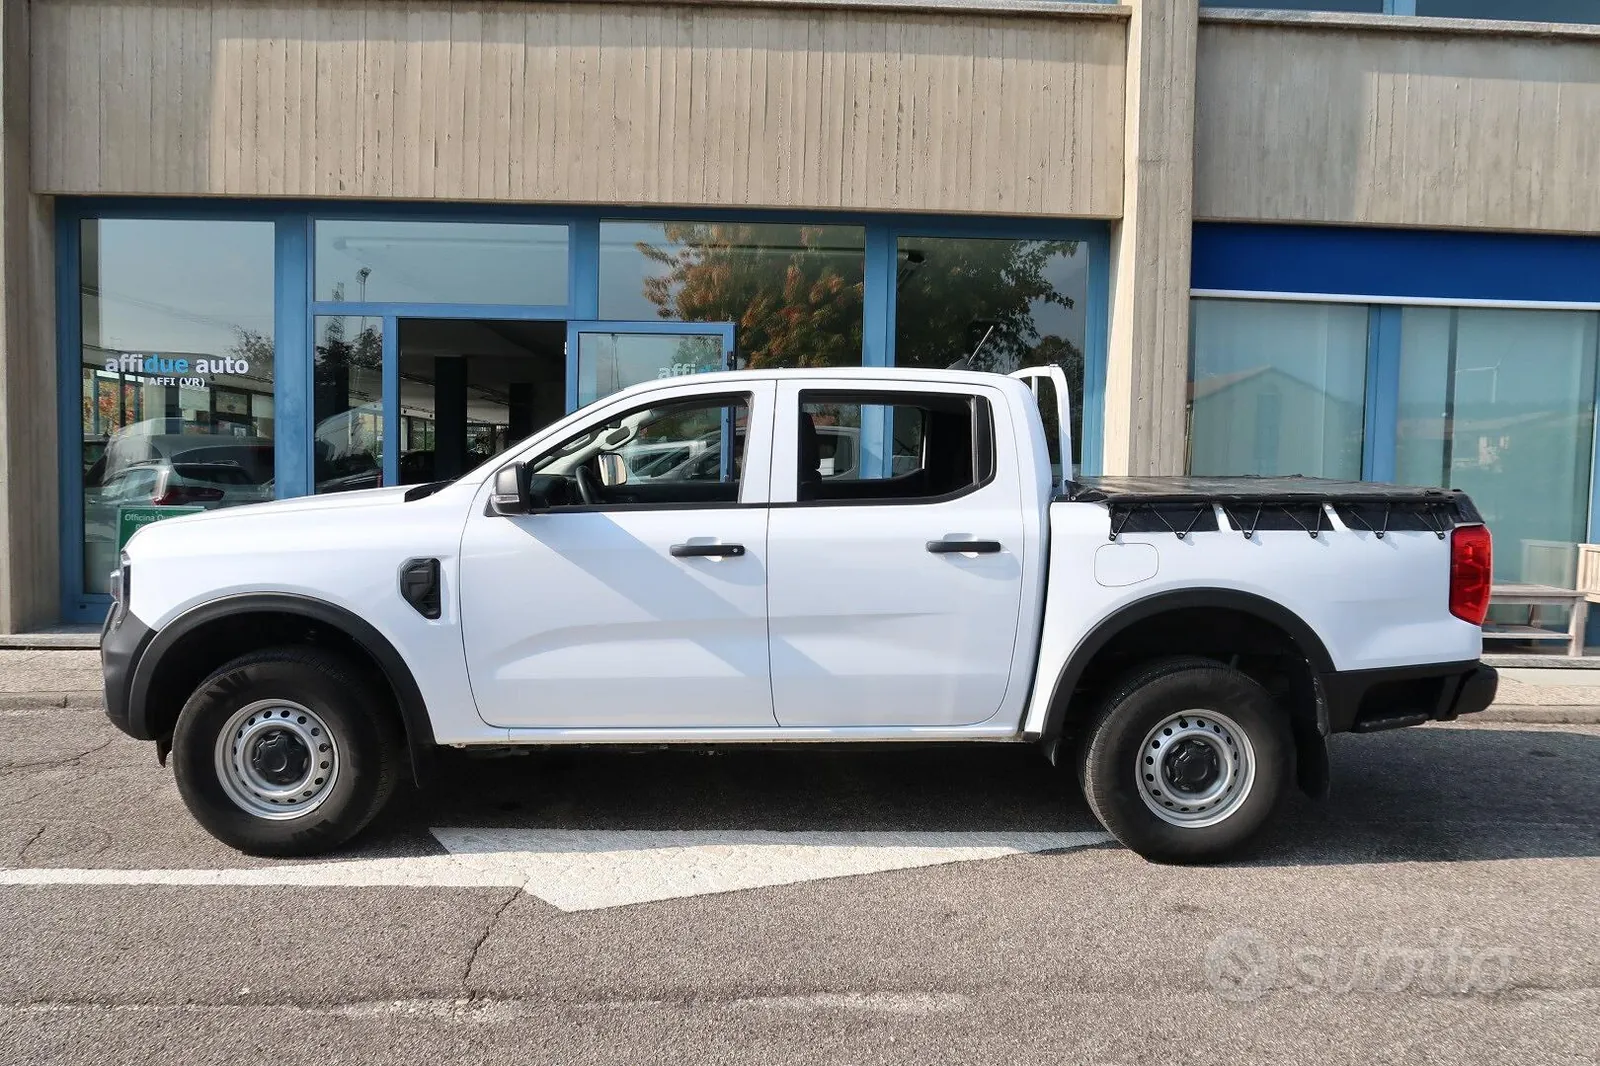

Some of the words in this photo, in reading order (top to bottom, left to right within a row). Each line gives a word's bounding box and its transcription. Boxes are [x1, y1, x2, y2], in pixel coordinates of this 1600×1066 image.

[105, 354, 188, 374] affidue
[195, 356, 249, 374] auto
[150, 377, 176, 386] AFFI
[179, 377, 205, 388] (VR)
[124, 513, 155, 522] Officina
